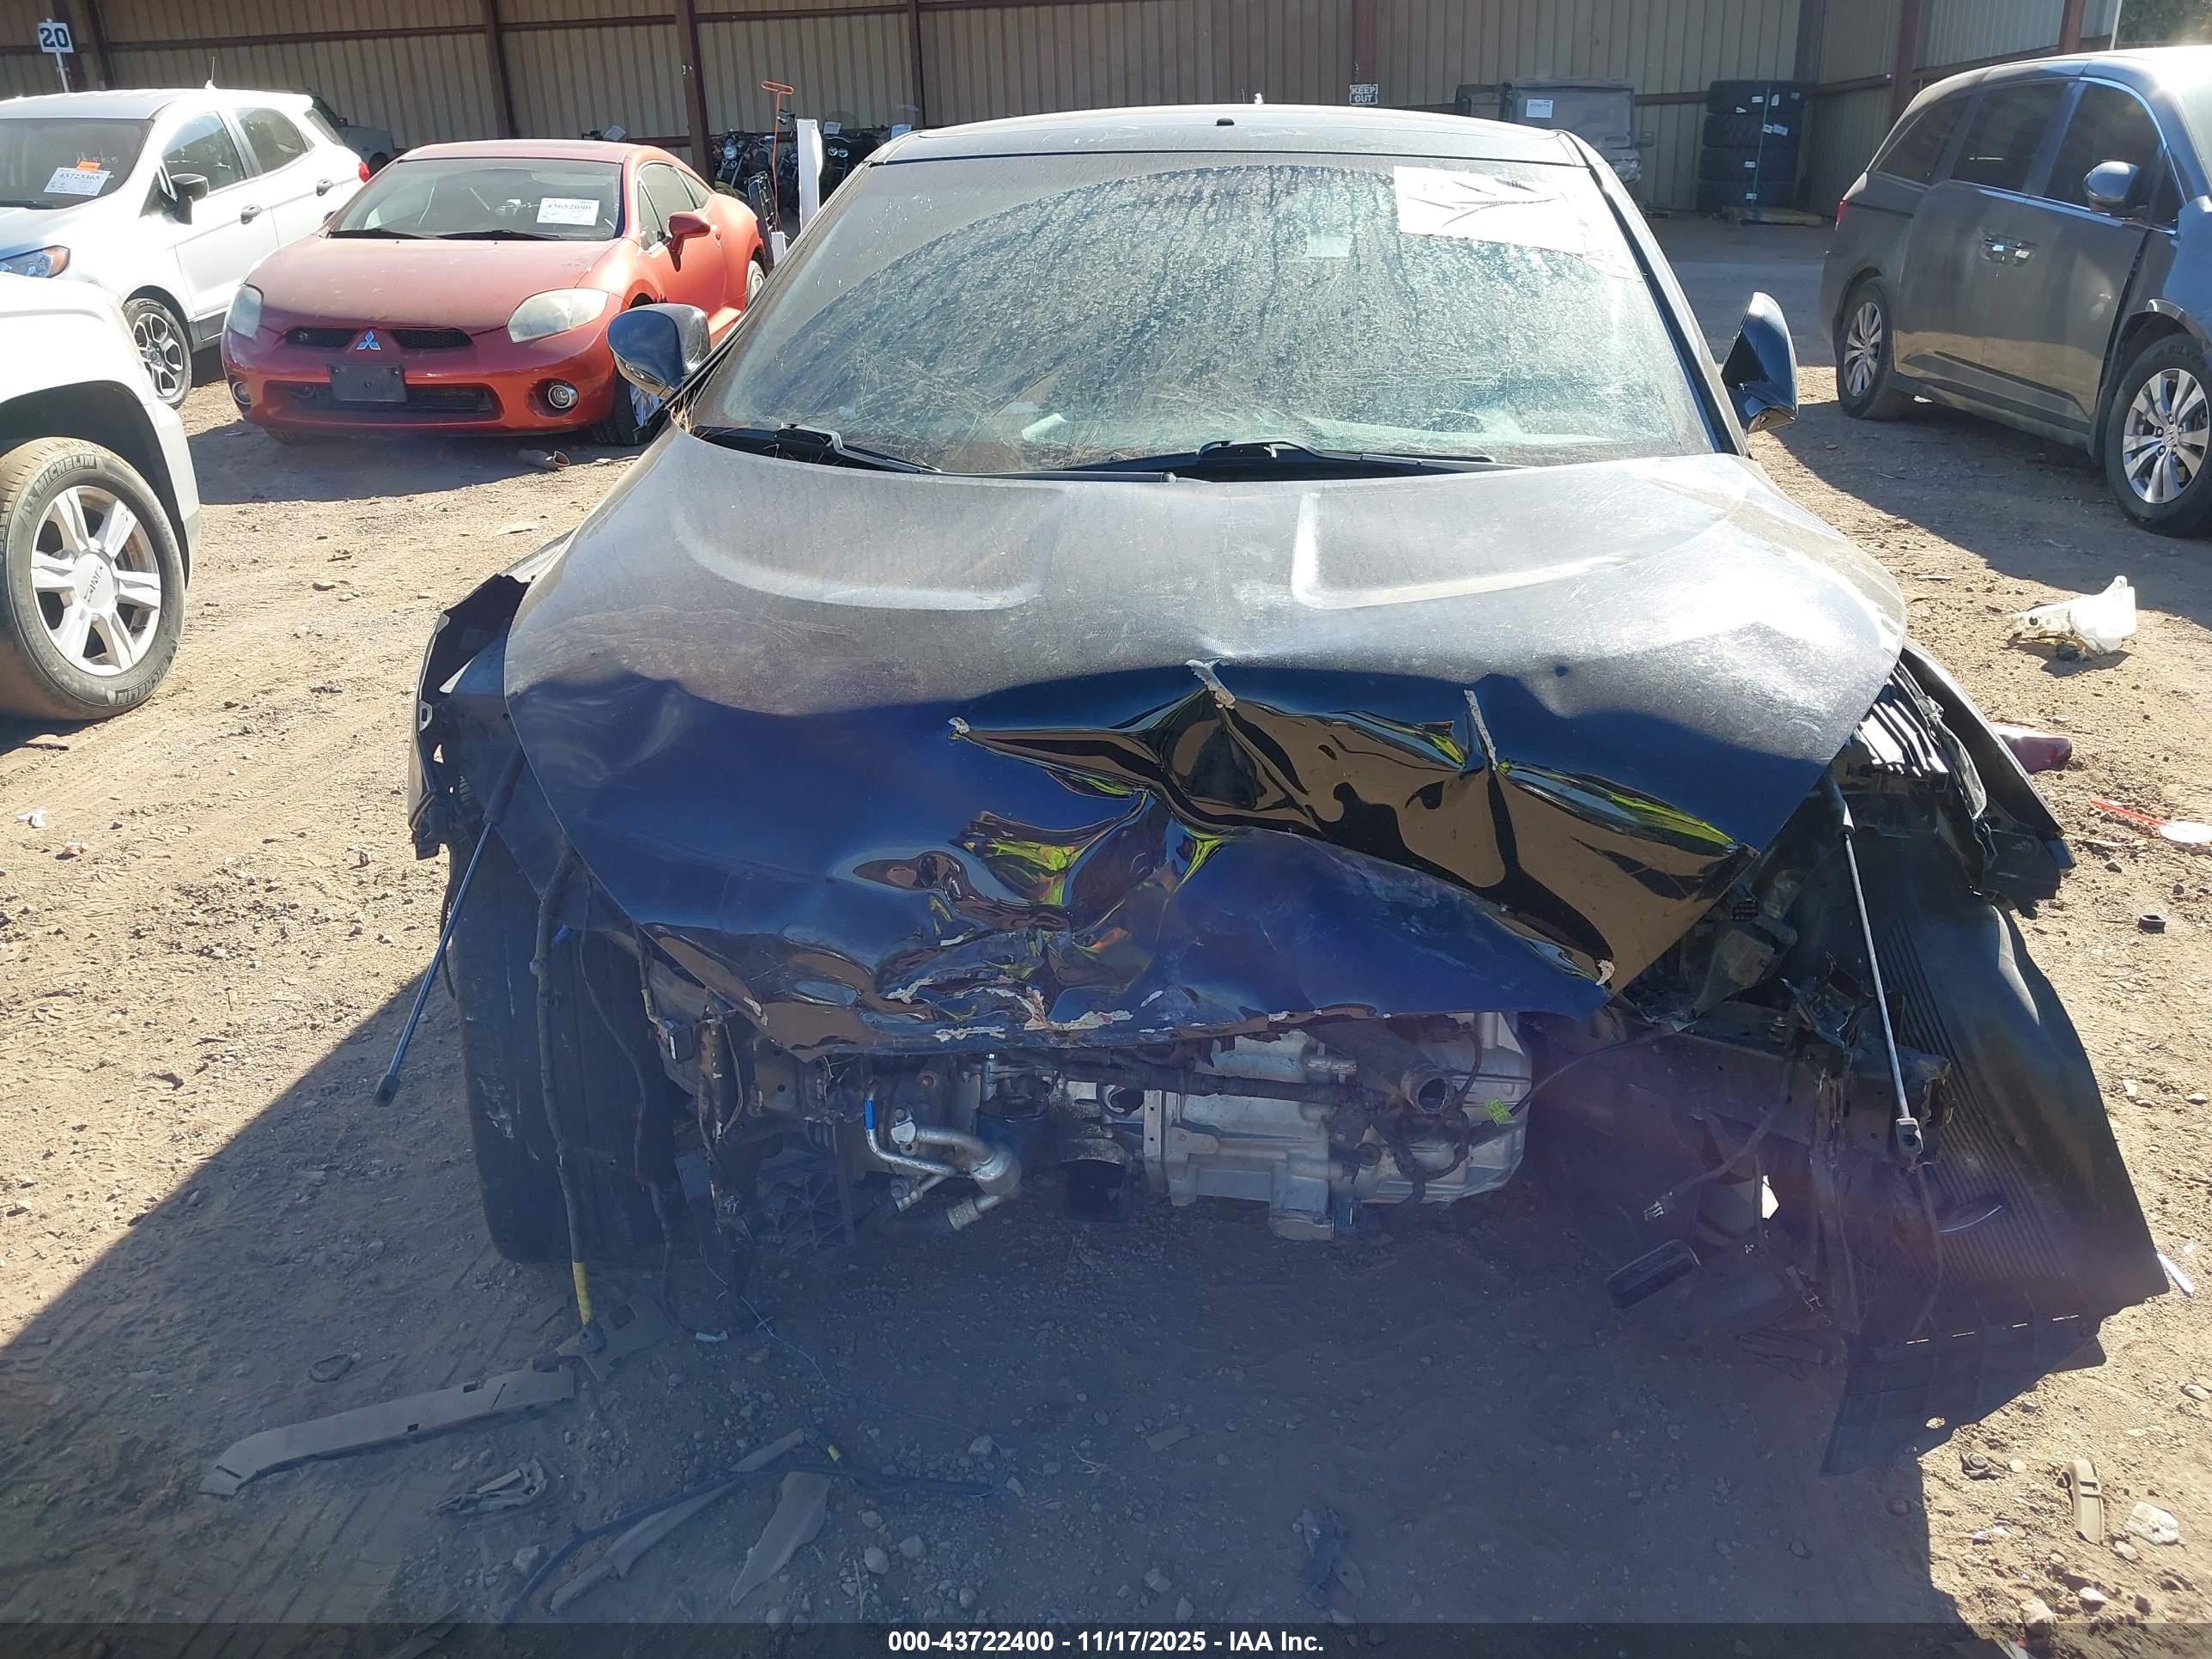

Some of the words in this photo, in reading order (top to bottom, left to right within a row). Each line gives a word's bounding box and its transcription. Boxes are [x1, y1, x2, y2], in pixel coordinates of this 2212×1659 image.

[40, 27, 70, 47] 20
[1352, 86, 1376, 94] KEEP
[1354, 94, 1374, 103] OUT
[34, 454, 95, 495] MICHELIN
